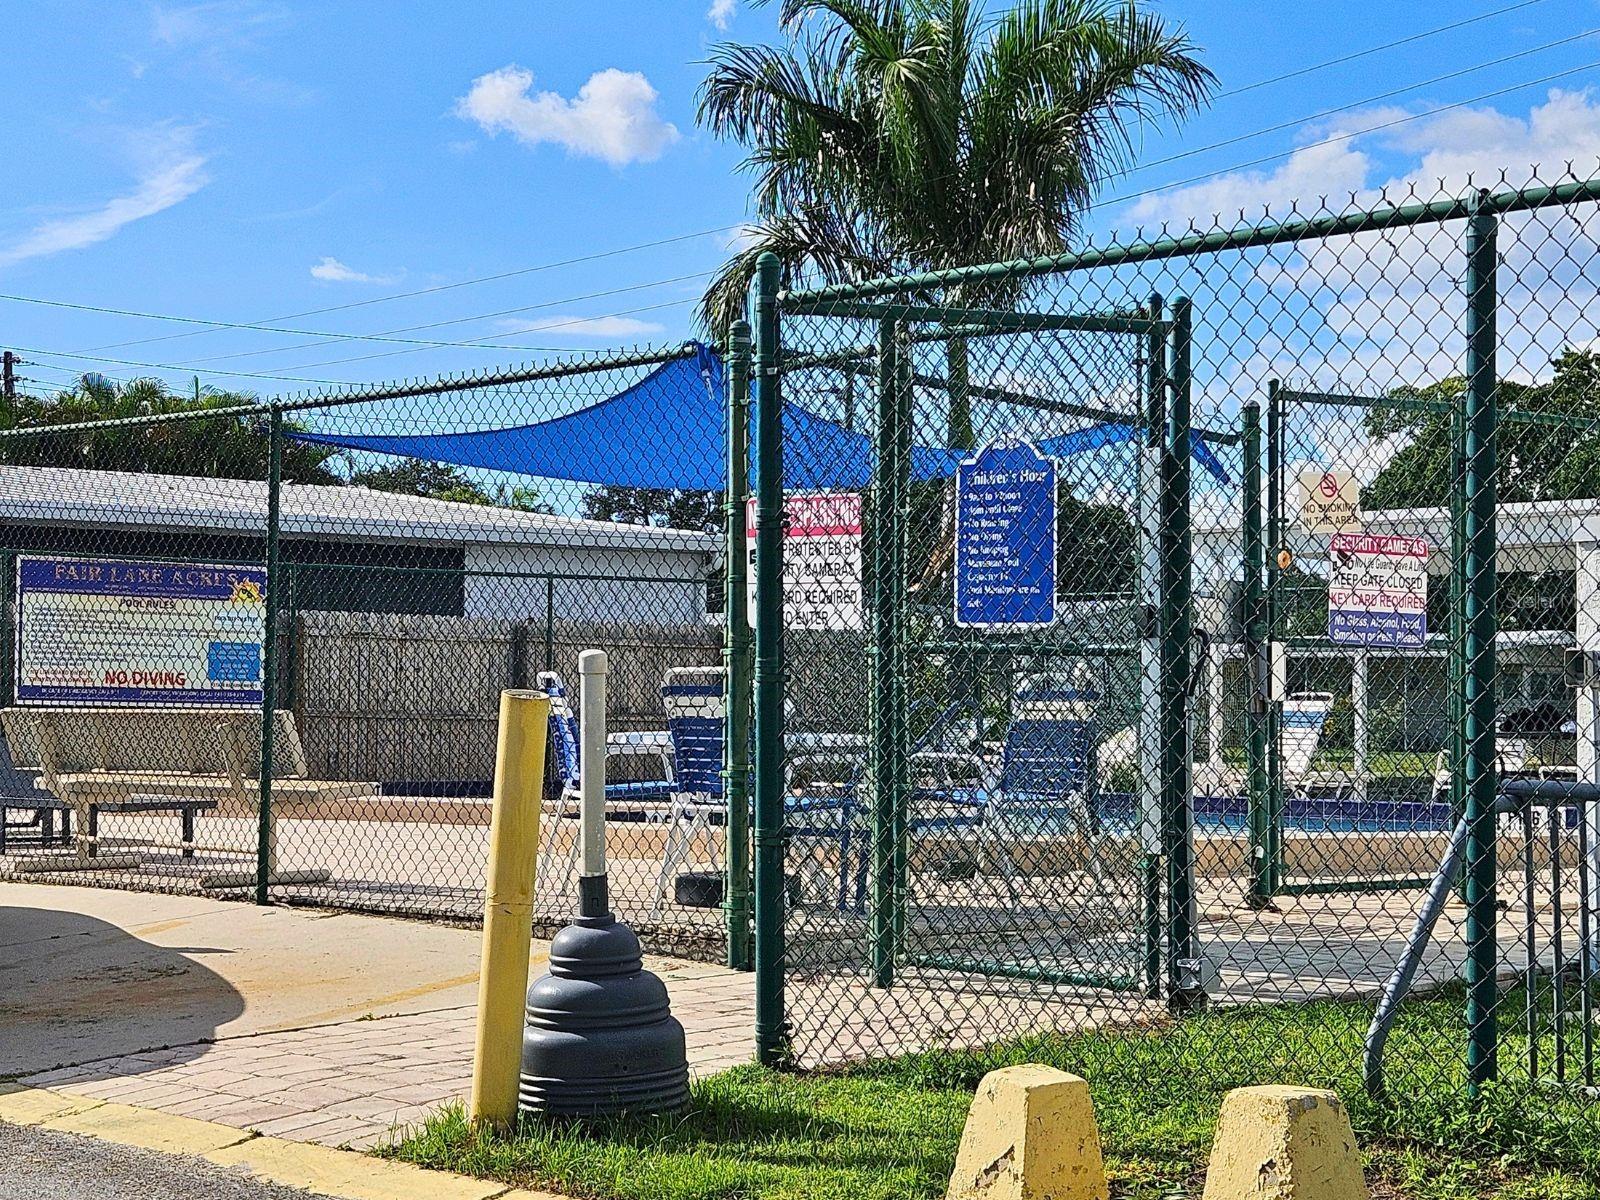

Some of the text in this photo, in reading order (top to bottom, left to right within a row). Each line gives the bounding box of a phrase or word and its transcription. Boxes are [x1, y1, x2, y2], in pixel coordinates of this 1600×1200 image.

[1303, 502, 1357, 514] NO SMOKING
[1303, 515, 1358, 526] IN THIS AREA
[783, 541, 859, 557] PROTECTED BY
[1334, 535, 1425, 555] SECURITY CAMERAS
[805, 563, 855, 577] CAMERAS
[1334, 572, 1423, 590] KEEP GATE CLOSED
[1331, 592, 1425, 609] KEY CARD REQUIRED
[795, 610, 828, 625] ENTER
[1334, 615, 1345, 626] No
[1334, 629, 1366, 643] Smoking
[105, 670, 128, 685] NO
[132, 671, 185, 687] DIVING
